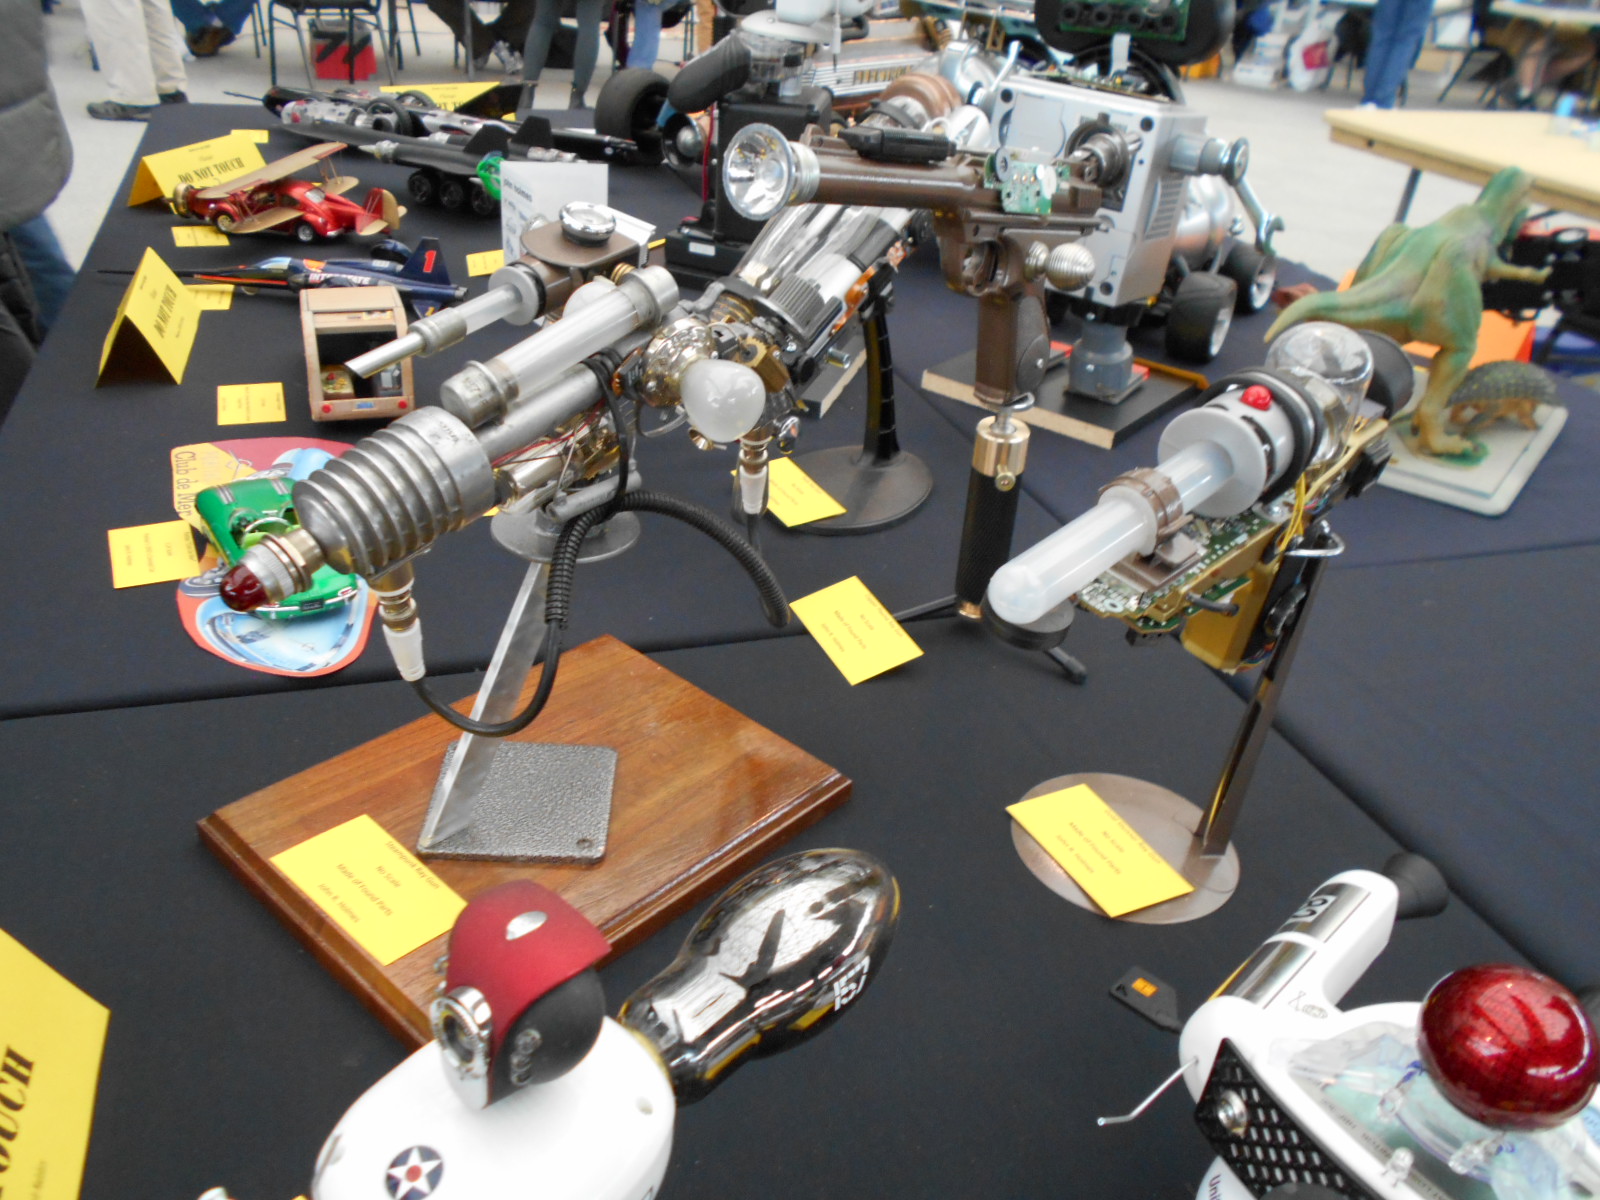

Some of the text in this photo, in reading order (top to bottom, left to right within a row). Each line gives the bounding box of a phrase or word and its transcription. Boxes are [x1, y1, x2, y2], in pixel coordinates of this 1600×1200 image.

[213, 157, 245, 178] TOUCH
[423, 250, 437, 273] 1
[175, 451, 198, 475] Club
[176, 478, 199, 490] de
[177, 493, 197, 517] Mer
[0, 1045, 34, 1200] UCH
